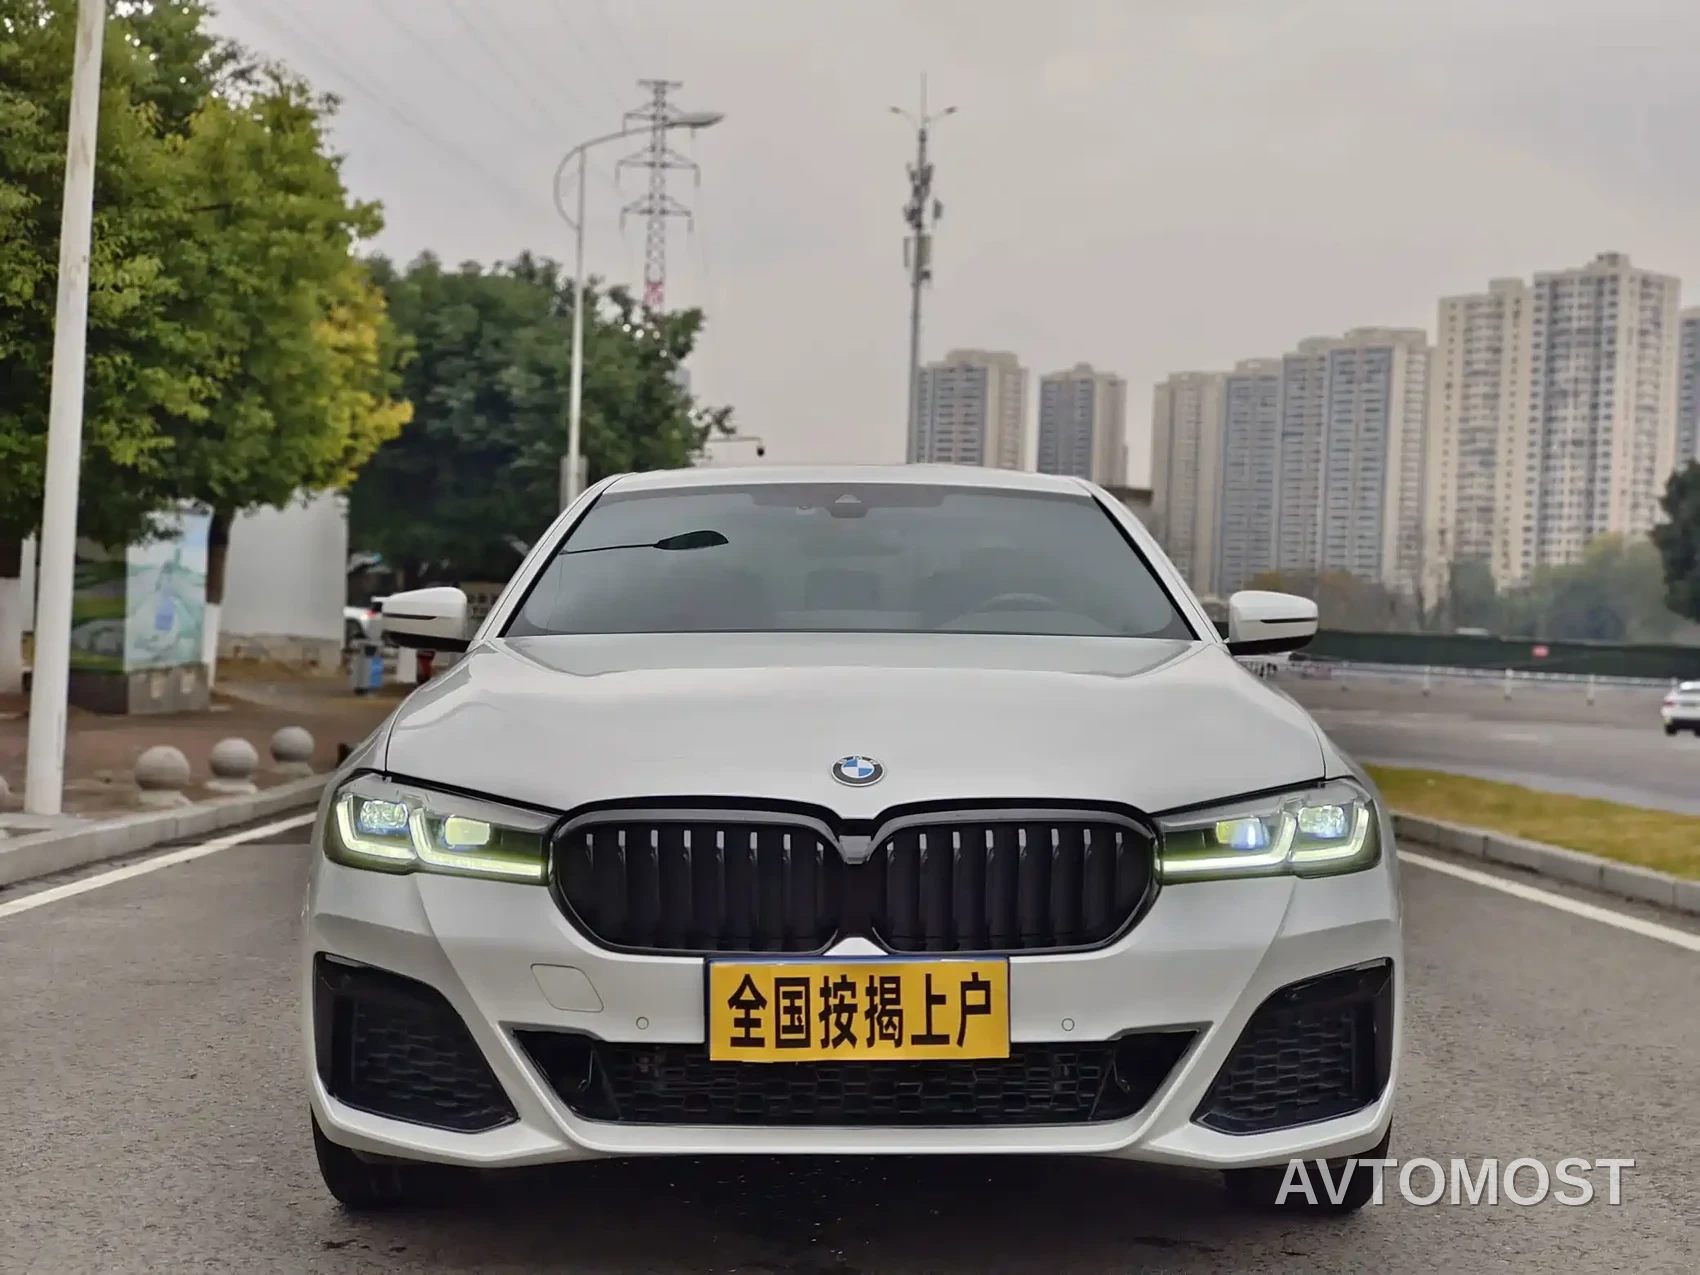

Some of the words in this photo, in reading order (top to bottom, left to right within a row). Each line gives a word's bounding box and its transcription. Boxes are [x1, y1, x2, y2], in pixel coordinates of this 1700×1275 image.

[727, 971, 992, 1049] 全国按揭上户
